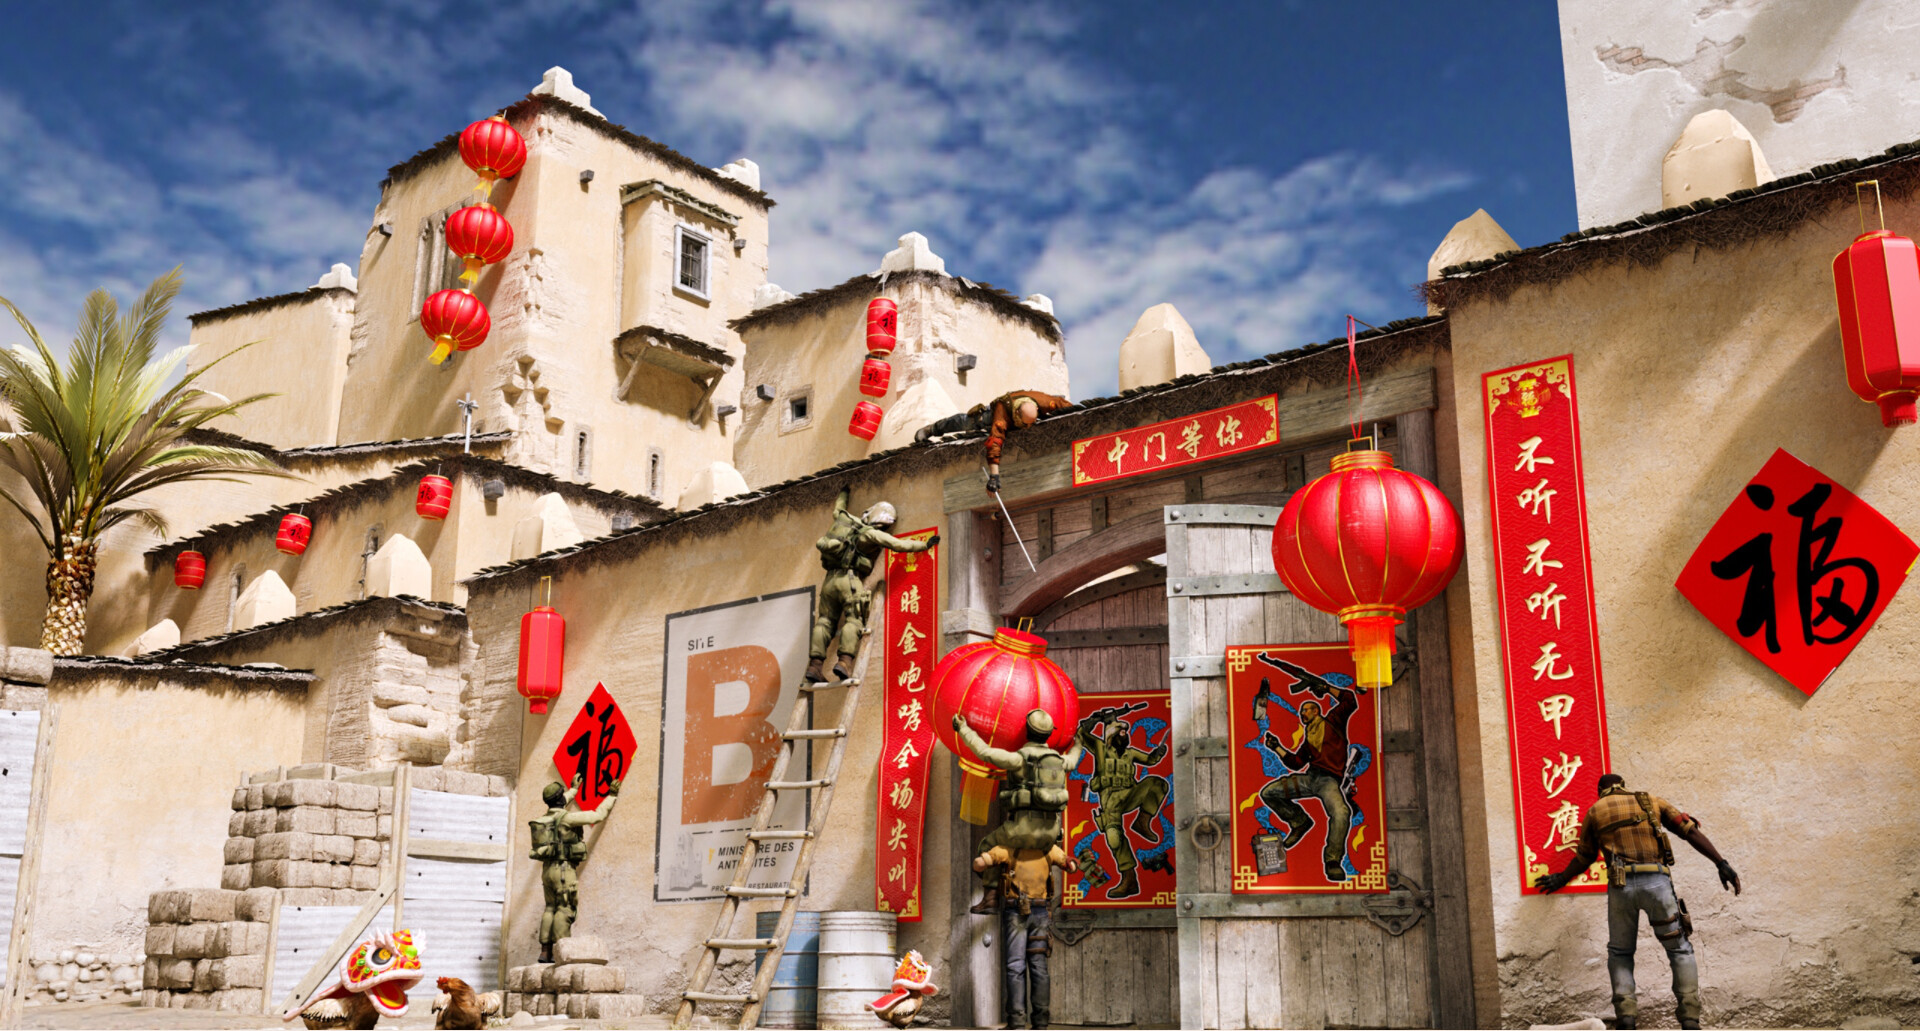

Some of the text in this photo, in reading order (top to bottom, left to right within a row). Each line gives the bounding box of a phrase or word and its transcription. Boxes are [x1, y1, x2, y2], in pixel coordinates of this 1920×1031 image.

[1107, 414, 1243, 475] 中门等你
[1711, 483, 1879, 654] 福
[1514, 436, 1583, 853] 不听不听无甲沙鹰
[567, 701, 623, 802] 福
[681, 645, 781, 825] B
[888, 584, 926, 892] 暗金咆哮全场尖叫
[717, 841, 795, 857] MINISRE DES
[717, 855, 777, 870] ANTITÉS
